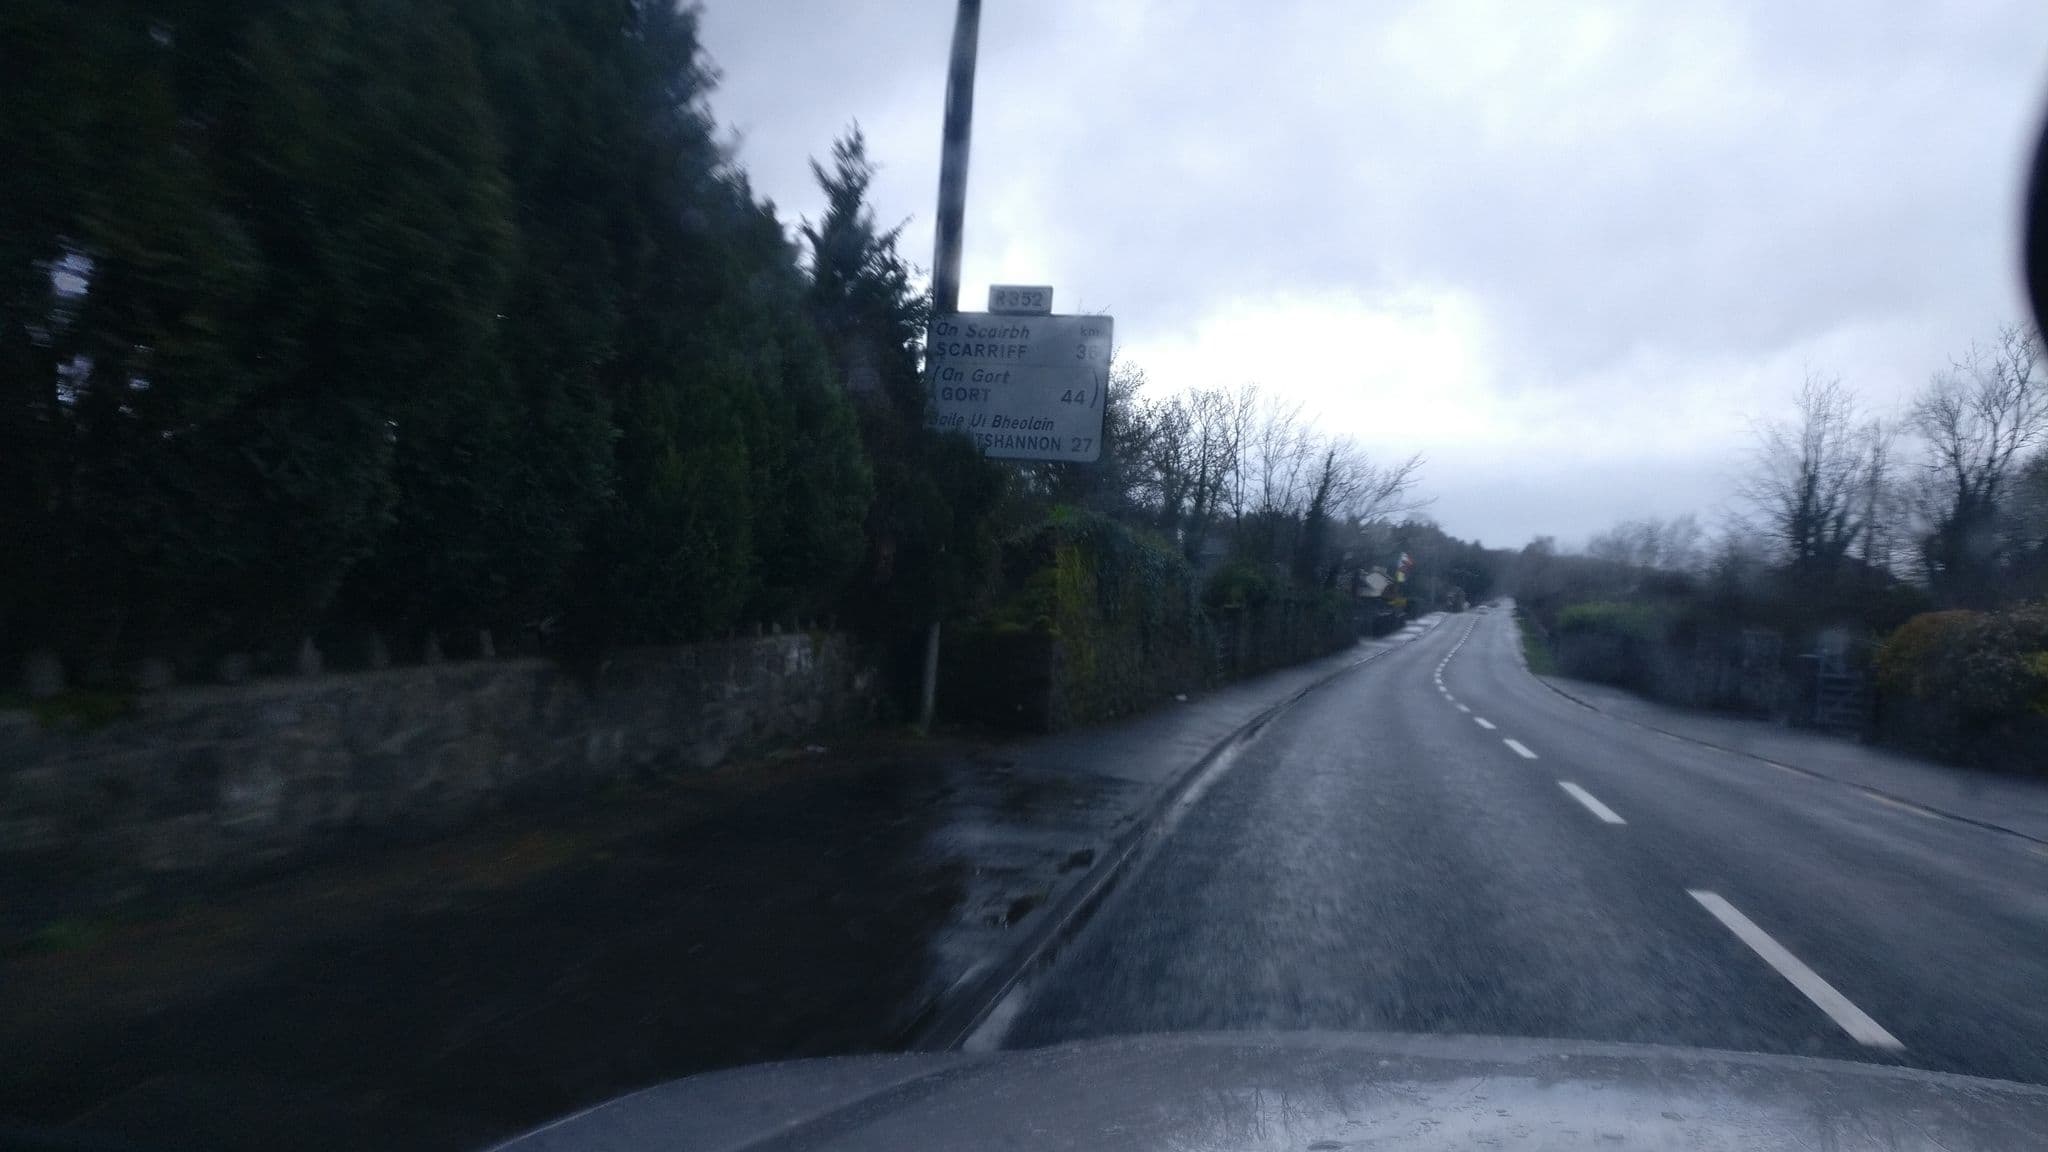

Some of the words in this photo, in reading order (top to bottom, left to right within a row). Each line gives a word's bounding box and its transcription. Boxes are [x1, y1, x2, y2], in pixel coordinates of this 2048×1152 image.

[995, 290, 1043, 307] R352
[965, 322, 1030, 339] Scairbh
[936, 342, 1029, 359] SCARRIFF
[971, 368, 1011, 385] Gort
[941, 387, 991, 403] GORT
[1071, 437, 1093, 453] 27
